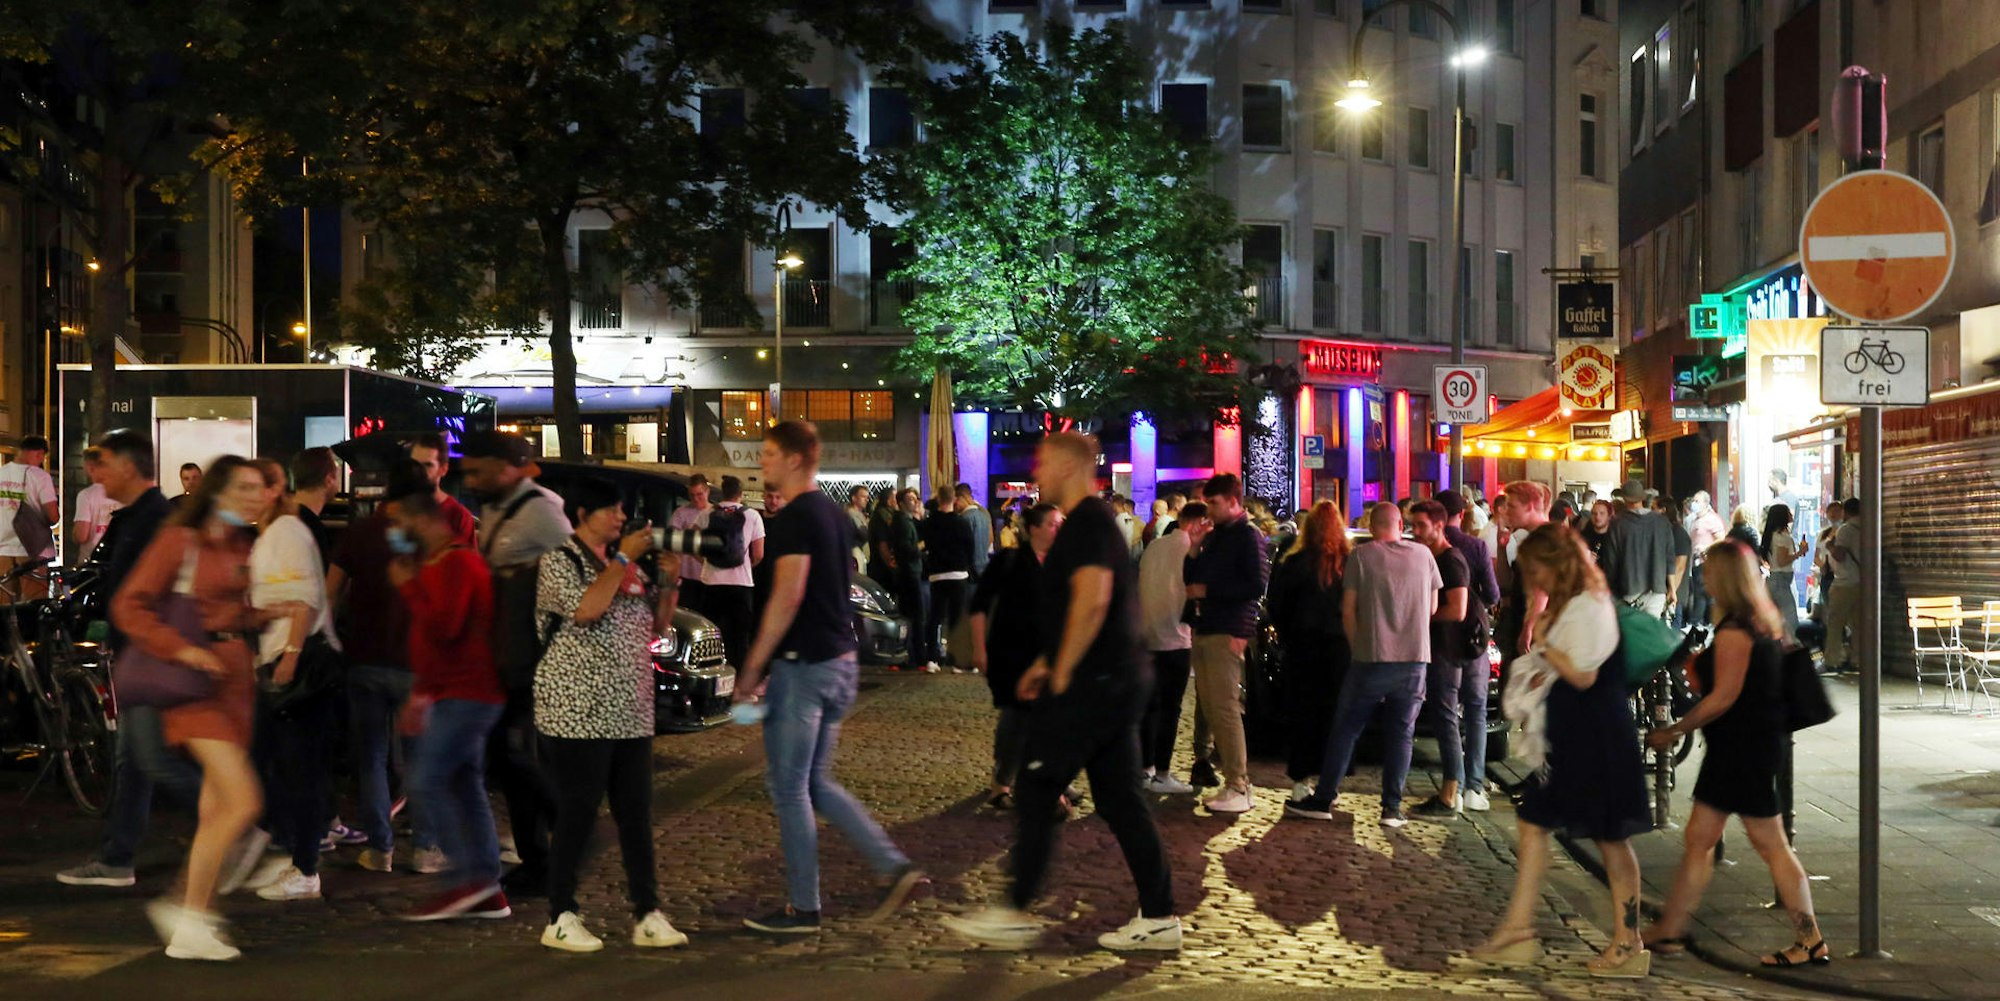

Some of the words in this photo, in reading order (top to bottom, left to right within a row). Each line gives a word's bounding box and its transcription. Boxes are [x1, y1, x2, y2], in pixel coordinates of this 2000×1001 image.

[1565, 307, 1607, 323] Gaffel
[1562, 345, 1612, 372] ROTER
[1680, 366, 1719, 385] sky
[1449, 381, 1469, 398] 30
[1562, 382, 1612, 408] PLATZ
[1859, 380, 1891, 395] frei
[1305, 438, 1317, 454] P
